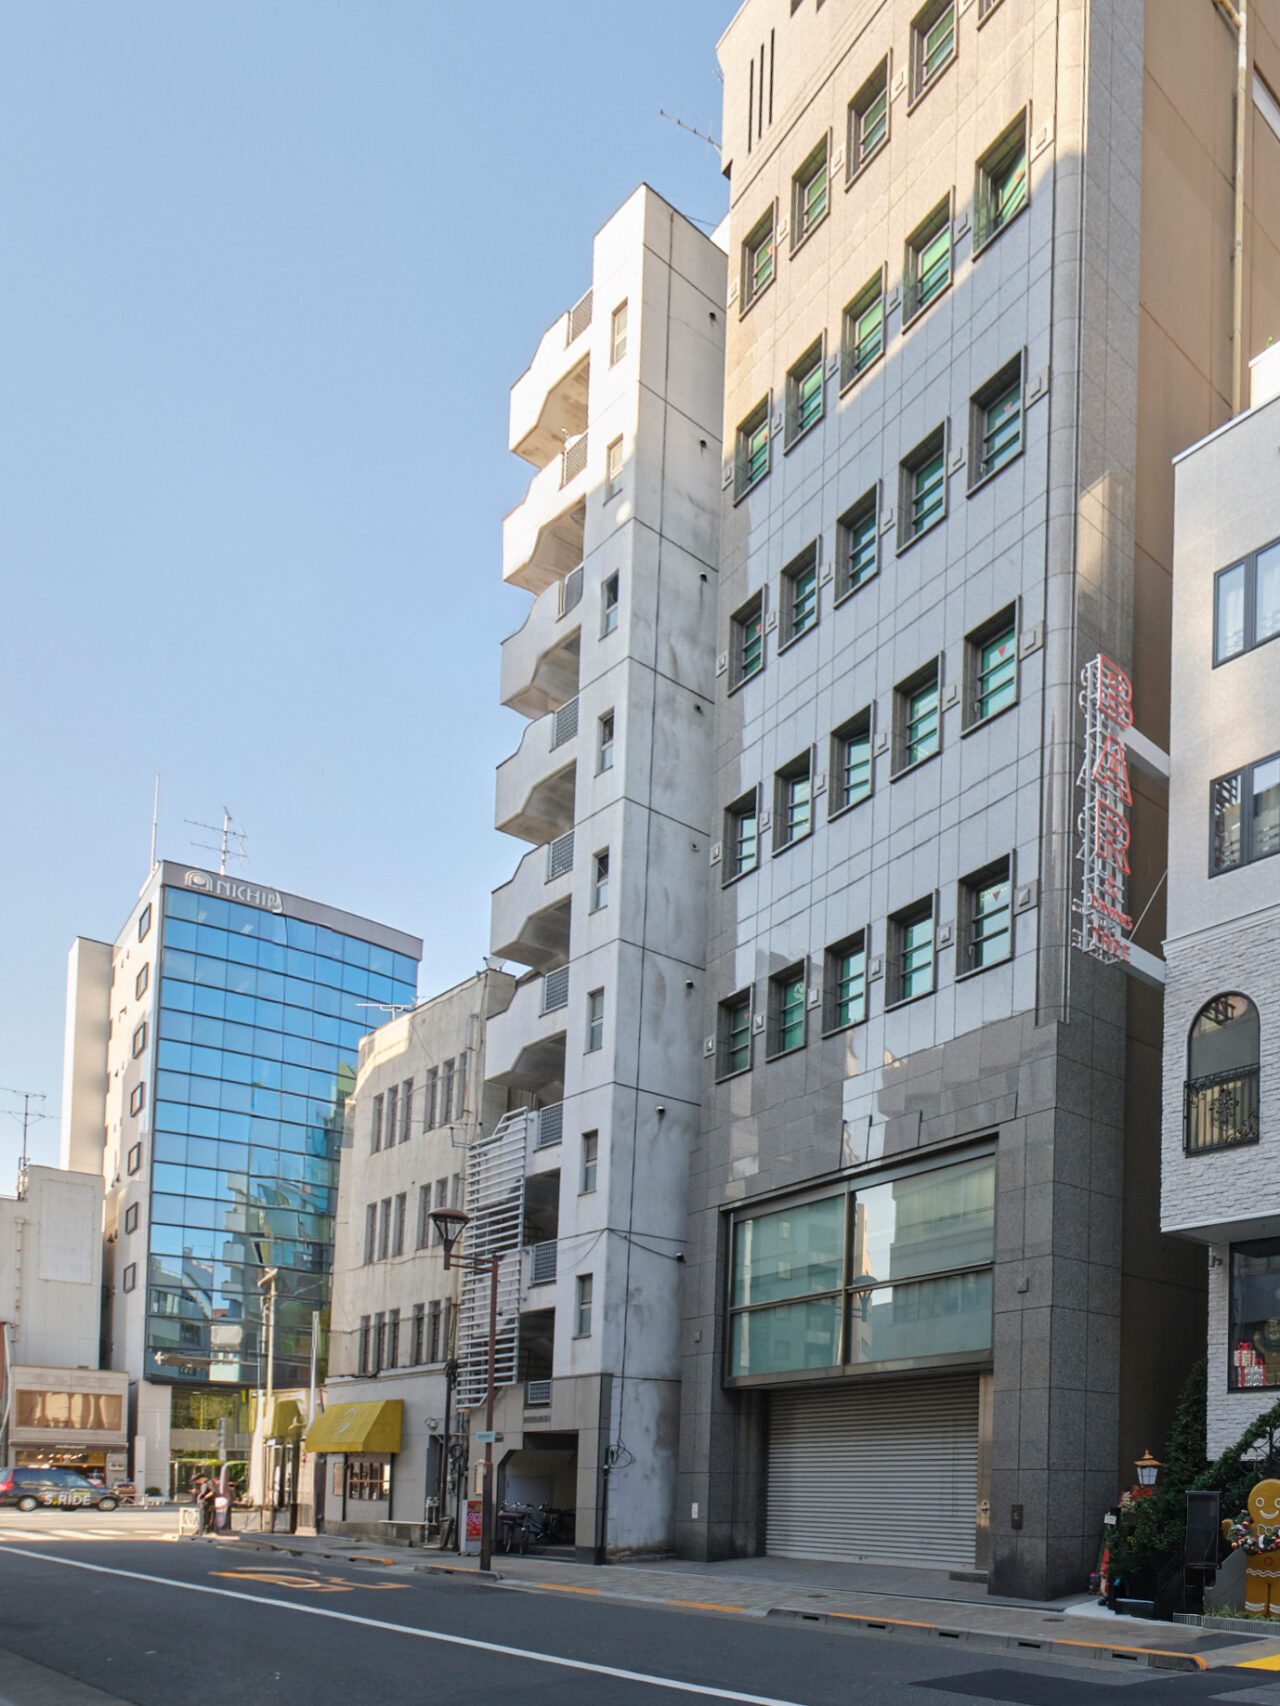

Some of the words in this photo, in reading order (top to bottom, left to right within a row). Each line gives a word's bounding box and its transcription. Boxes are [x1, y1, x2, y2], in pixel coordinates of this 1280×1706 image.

[1094, 653, 1133, 875] BAR
[1104, 873, 1119, 897] &
[1087, 893, 1133, 931] DINING
[1087, 924, 1131, 964] TREE
